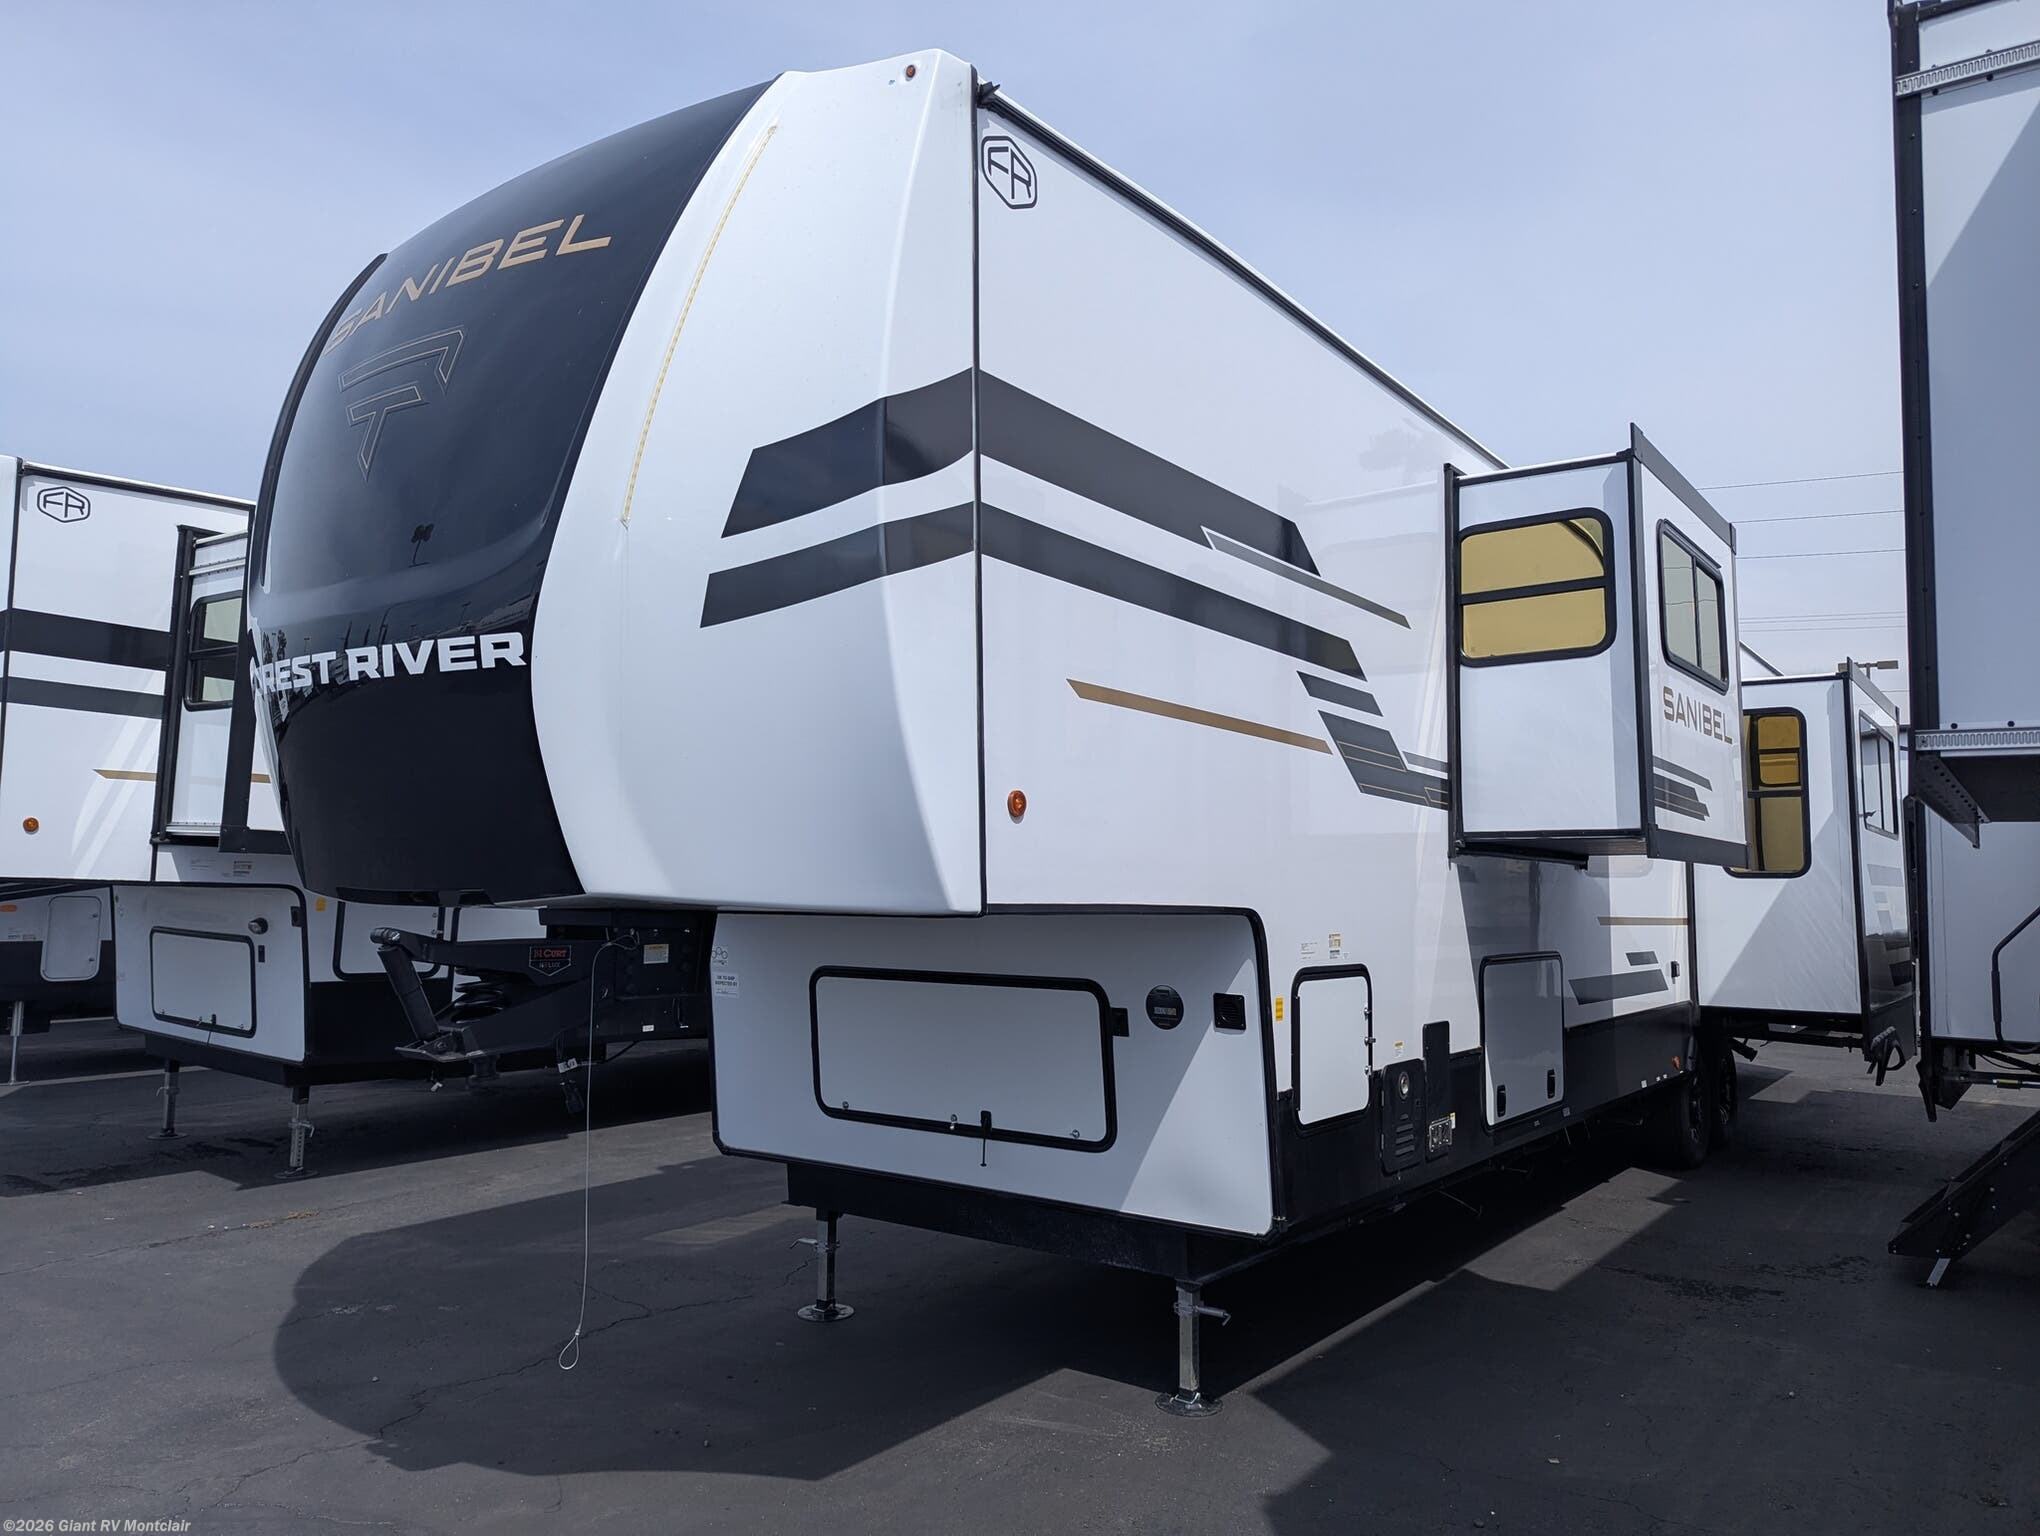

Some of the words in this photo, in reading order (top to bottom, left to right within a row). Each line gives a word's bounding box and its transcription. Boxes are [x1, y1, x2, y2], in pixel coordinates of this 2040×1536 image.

[321, 213, 612, 357] SANIBEL
[345, 631, 527, 681] RIVER
[1663, 685, 1734, 745] SANIBEL
